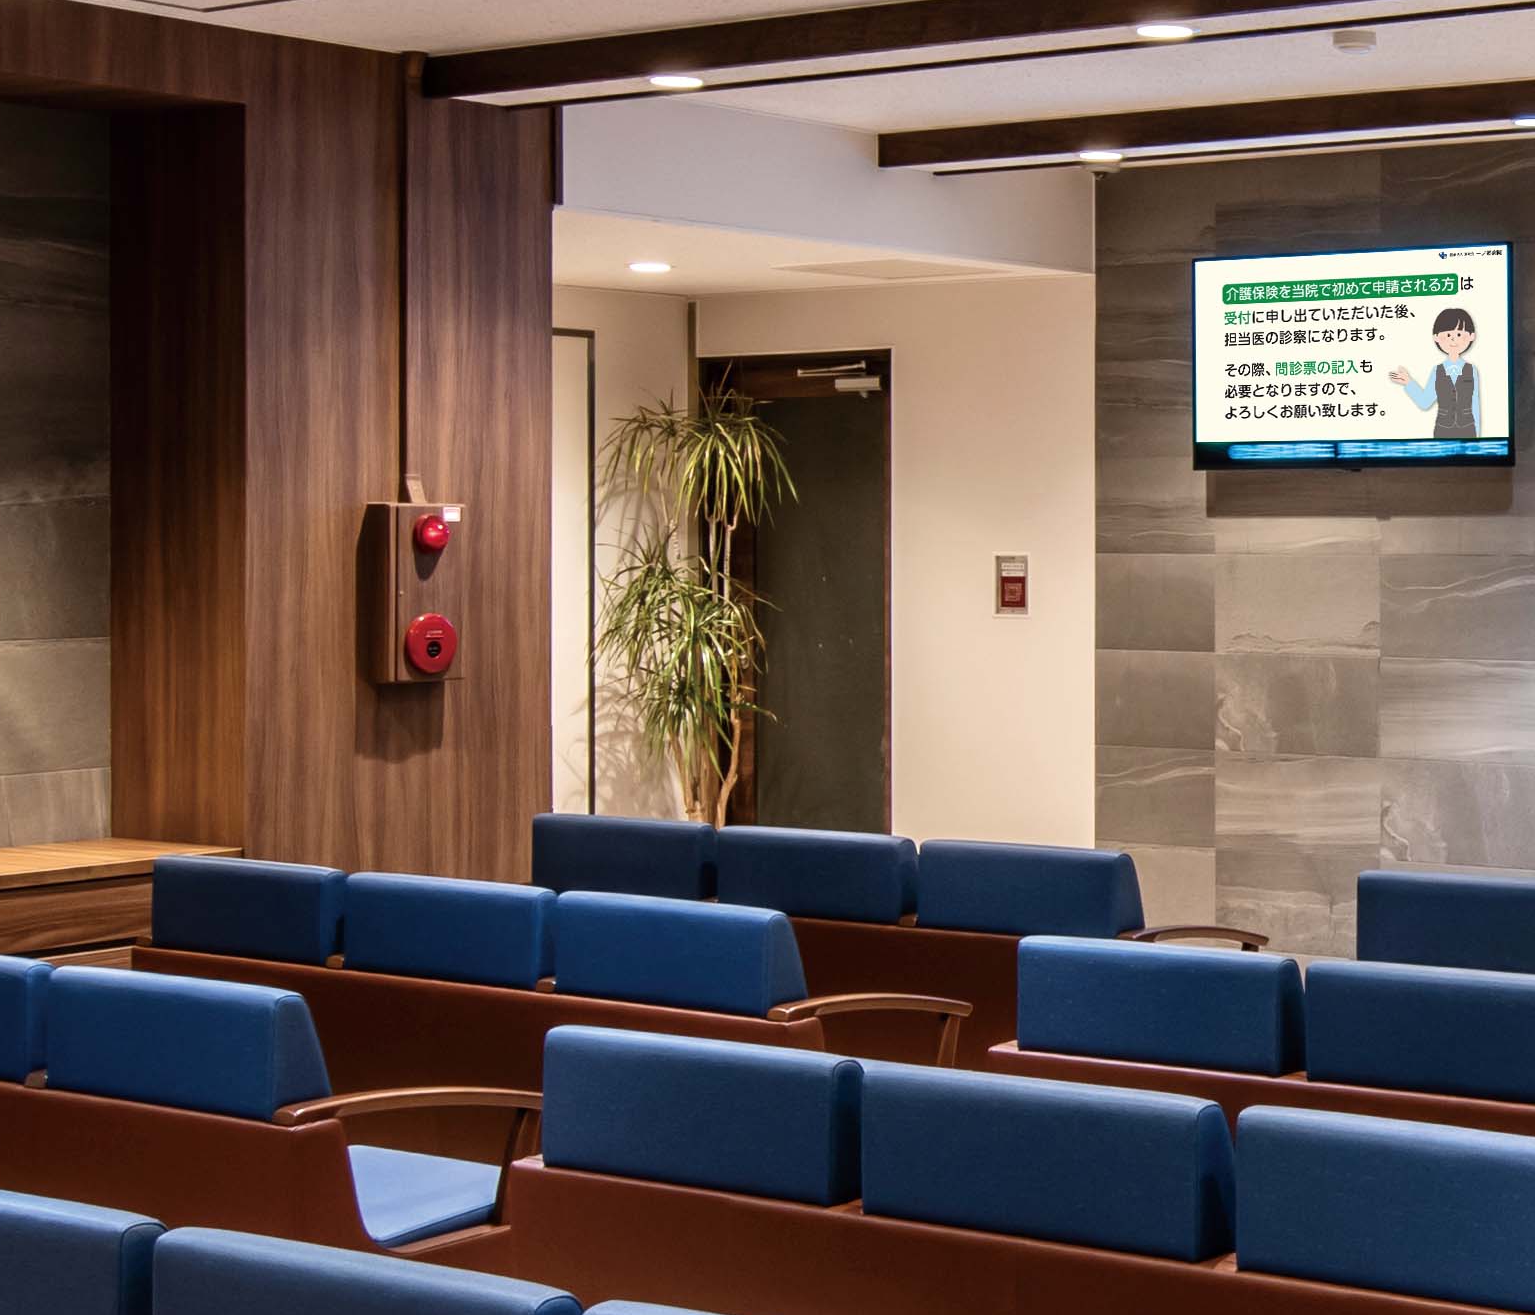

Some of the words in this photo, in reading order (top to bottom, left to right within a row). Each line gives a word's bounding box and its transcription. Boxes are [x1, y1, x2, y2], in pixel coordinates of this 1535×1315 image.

[1225, 276, 1474, 302] 介護保険を当院で初めて申請される方は
[1224, 304, 1416, 325] 受付に申し出ていただいた後、
[1224, 328, 1386, 347] 担当医の診察になります。
[1224, 360, 1373, 377] その際、問診票の記入も
[1224, 382, 1357, 398] 必要となりますので、
[1224, 402, 1387, 420] よろしくお願い致します。
